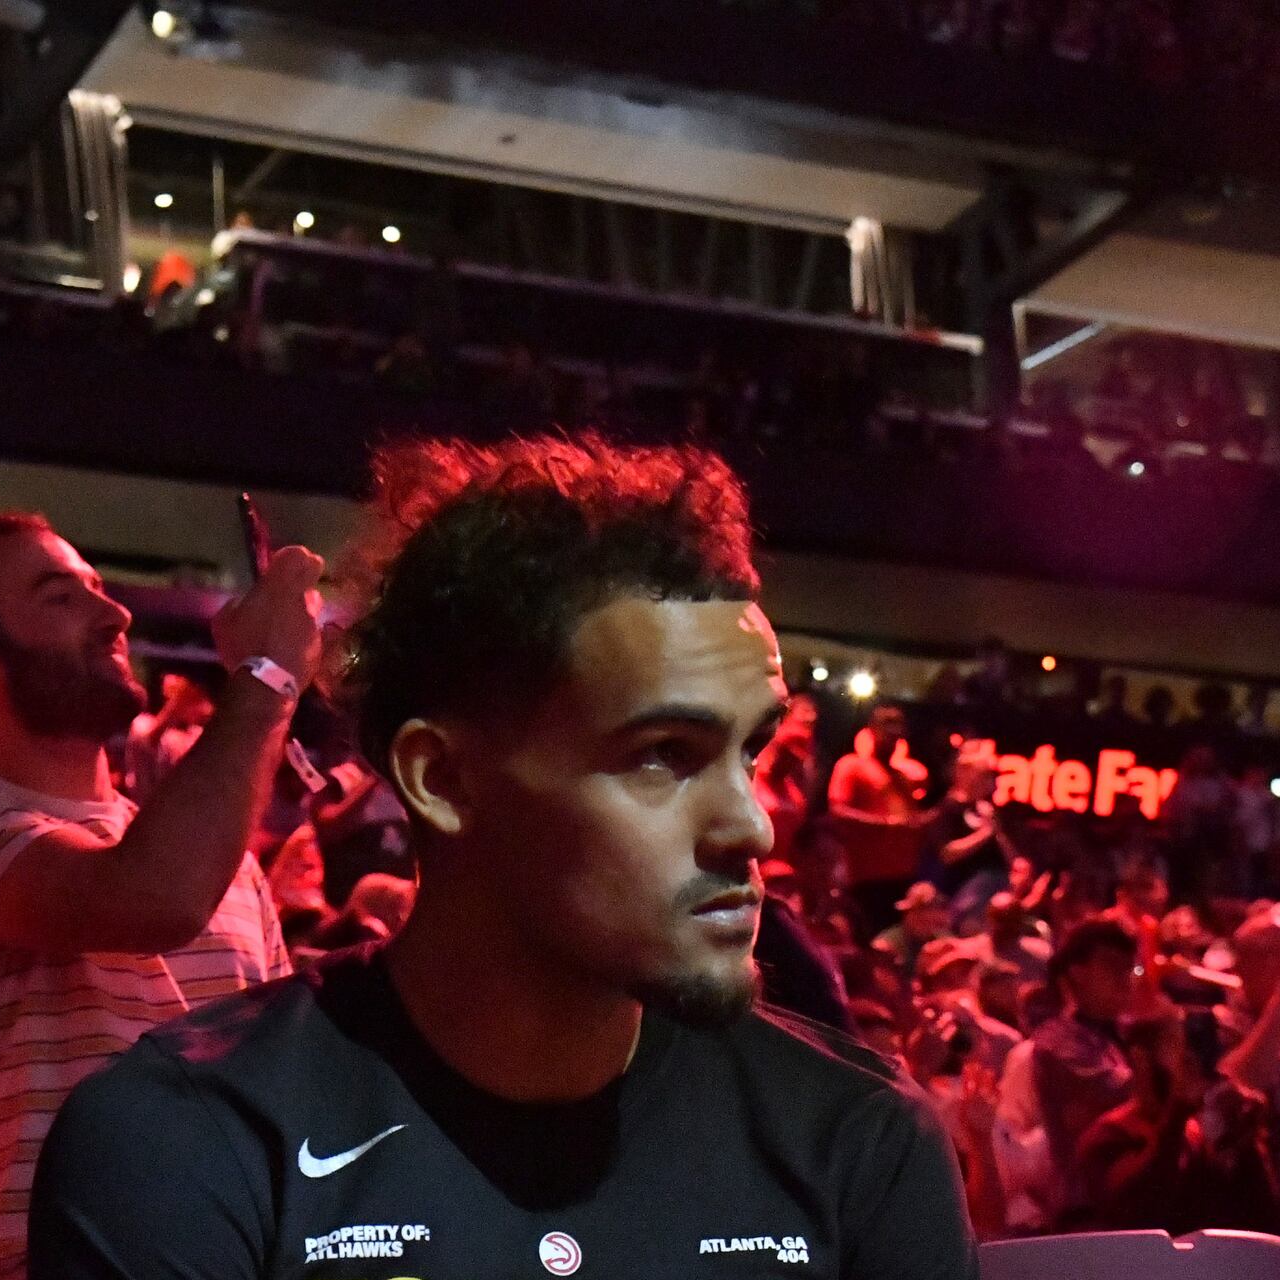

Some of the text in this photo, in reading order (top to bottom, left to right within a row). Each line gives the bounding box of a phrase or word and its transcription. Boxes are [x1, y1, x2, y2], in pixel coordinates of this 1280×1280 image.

[304, 1224, 431, 1253] PROPERTY OF:
[699, 1236, 808, 1254] ATLANTA, GA
[304, 1241, 404, 1264] ATL HAWKS
[777, 1249, 809, 1263] 404
